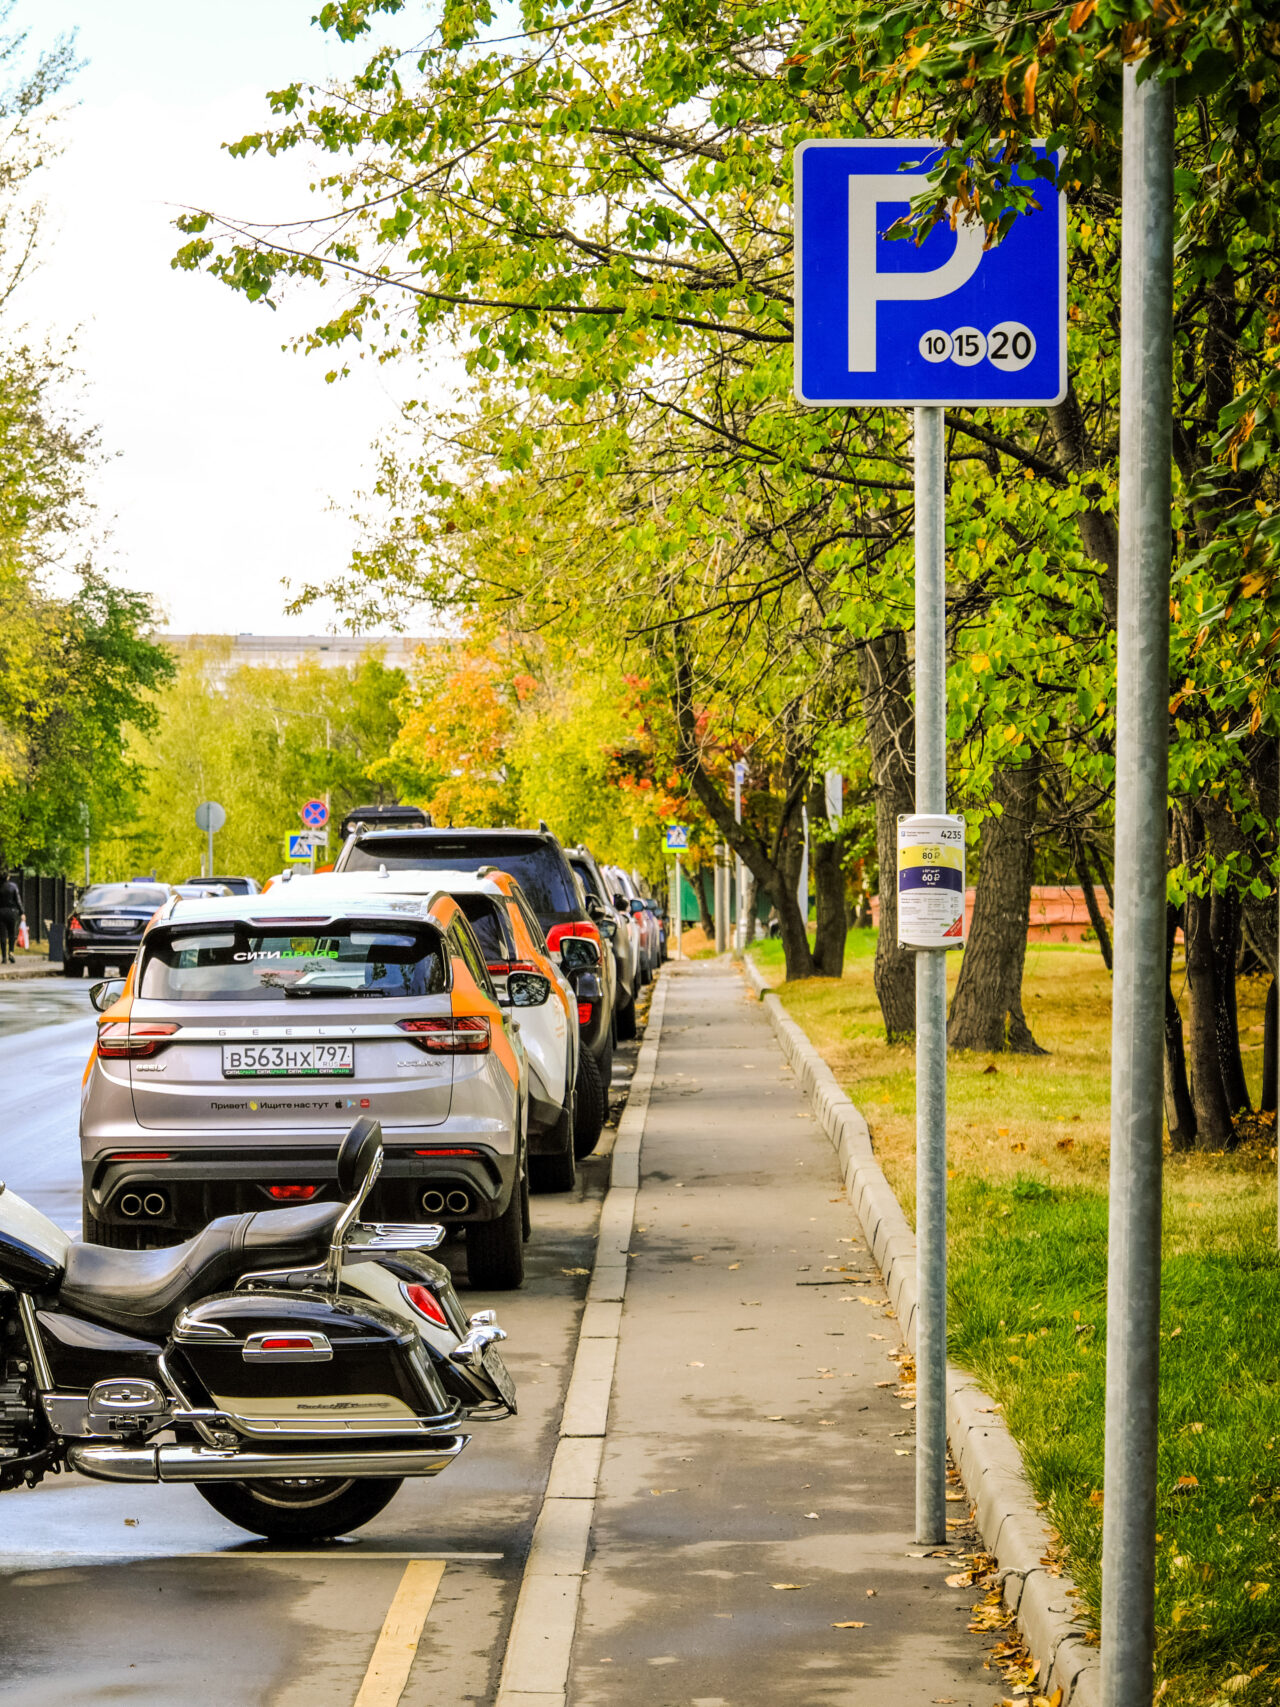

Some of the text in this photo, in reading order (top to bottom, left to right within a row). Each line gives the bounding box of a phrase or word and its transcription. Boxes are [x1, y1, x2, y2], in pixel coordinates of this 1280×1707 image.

[848, 174, 986, 372] P
[925, 331, 1032, 360] 10 15 20
[940, 830, 962, 840] 4235
[922, 852, 933, 860] 80
[922, 873, 933, 882] 60
[218, 1027, 357, 1036] GEELY
[230, 1046, 348, 1068] В563НХ 797
[210, 1102, 248, 1110] Привет!
